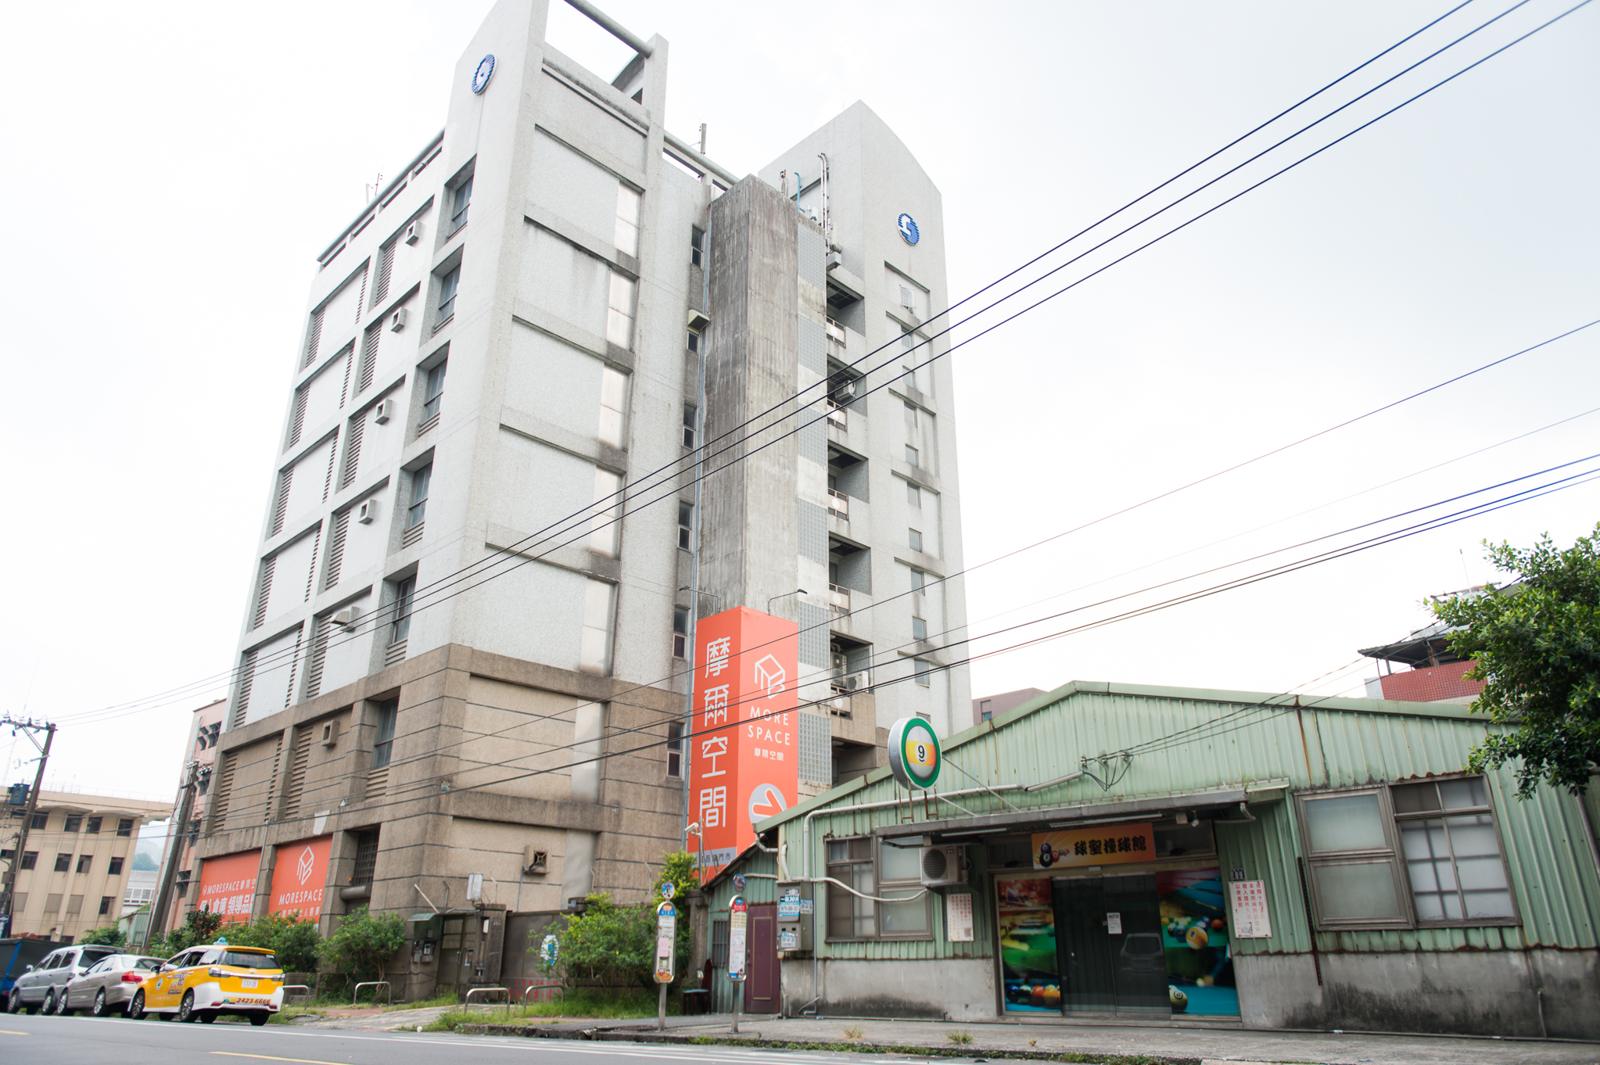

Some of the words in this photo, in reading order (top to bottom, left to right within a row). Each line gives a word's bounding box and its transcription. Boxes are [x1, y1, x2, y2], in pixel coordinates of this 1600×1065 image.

[750, 706, 789, 726] MORE
[699, 636, 731, 828] 摩爾空間
[747, 726, 791, 746] SPACE
[917, 744, 926, 759] 9
[206, 880, 240, 895] MORESPACE
[279, 888, 323, 905] MORESPACE
